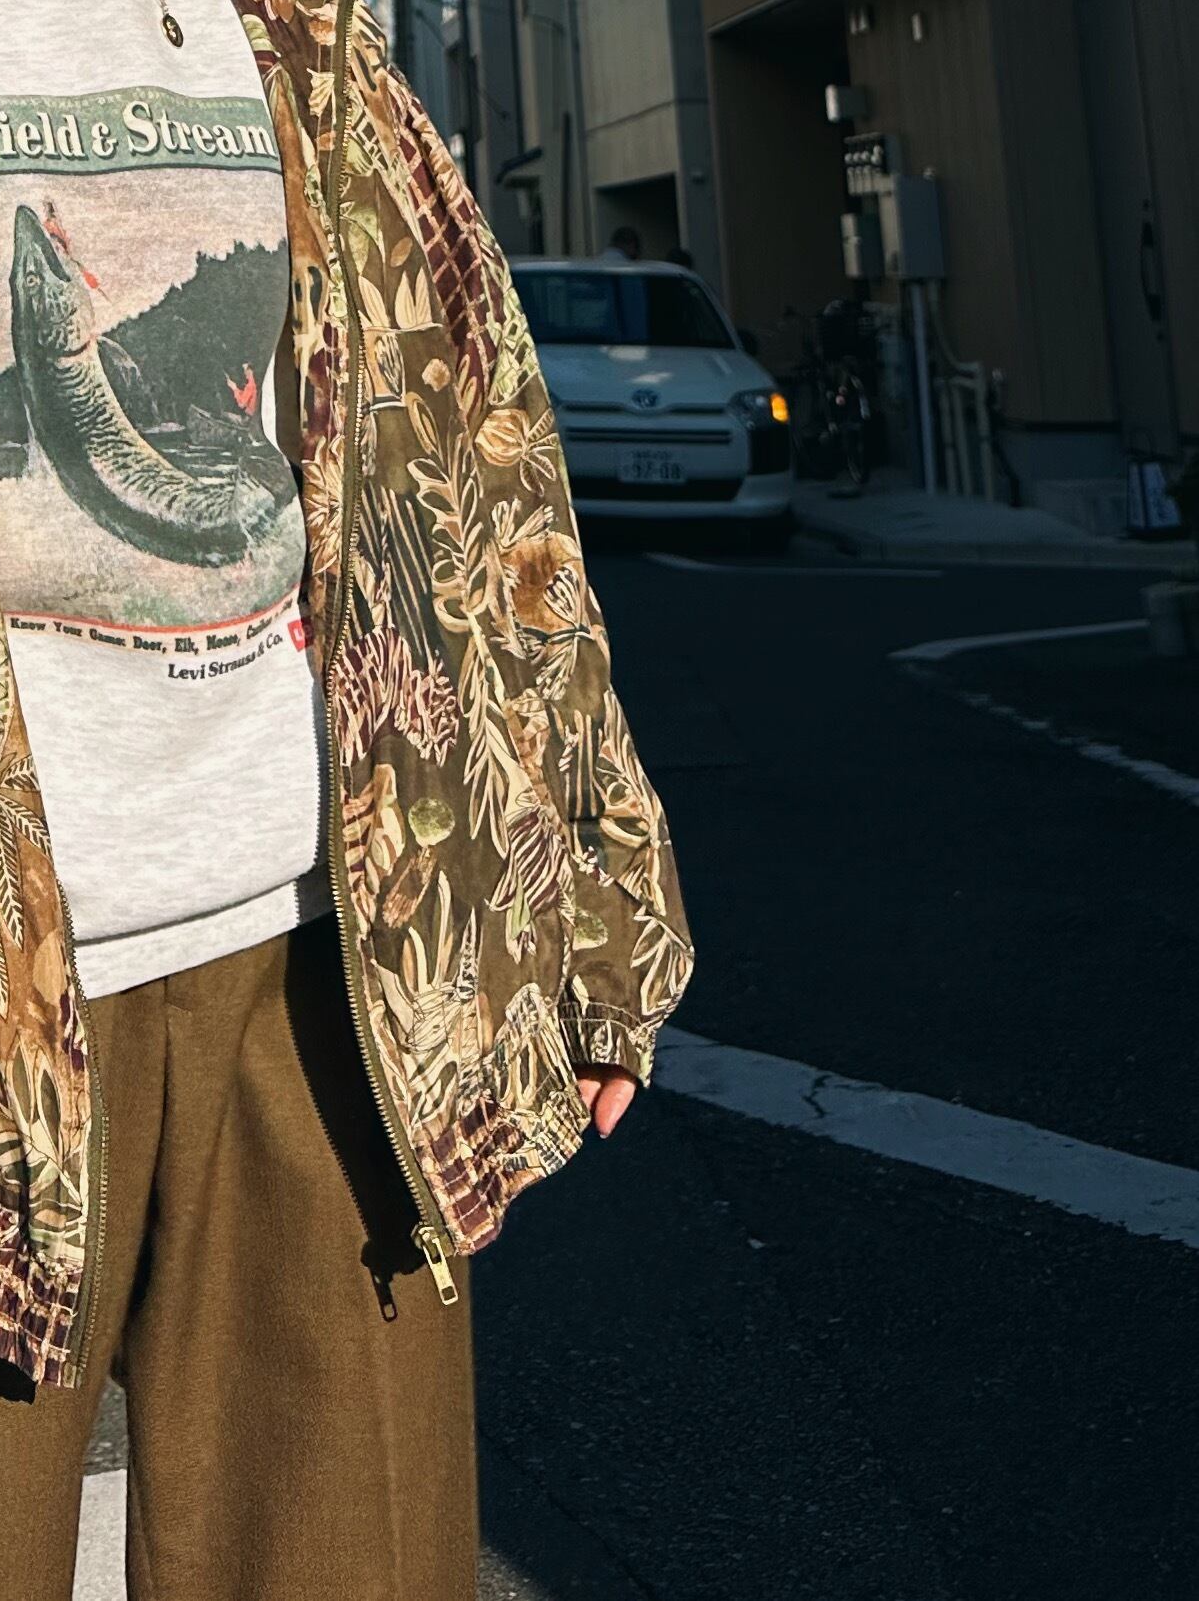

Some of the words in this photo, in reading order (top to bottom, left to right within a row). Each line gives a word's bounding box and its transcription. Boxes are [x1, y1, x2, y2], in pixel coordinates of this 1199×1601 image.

[91, 121, 119, 161] &
[122, 100, 278, 162] Stream
[10, 617, 46, 631] Know
[53, 621, 83, 637] Your
[167, 663, 206, 679] Levi
[207, 651, 256, 678] Strauss
[266, 633, 283, 649] Co.
